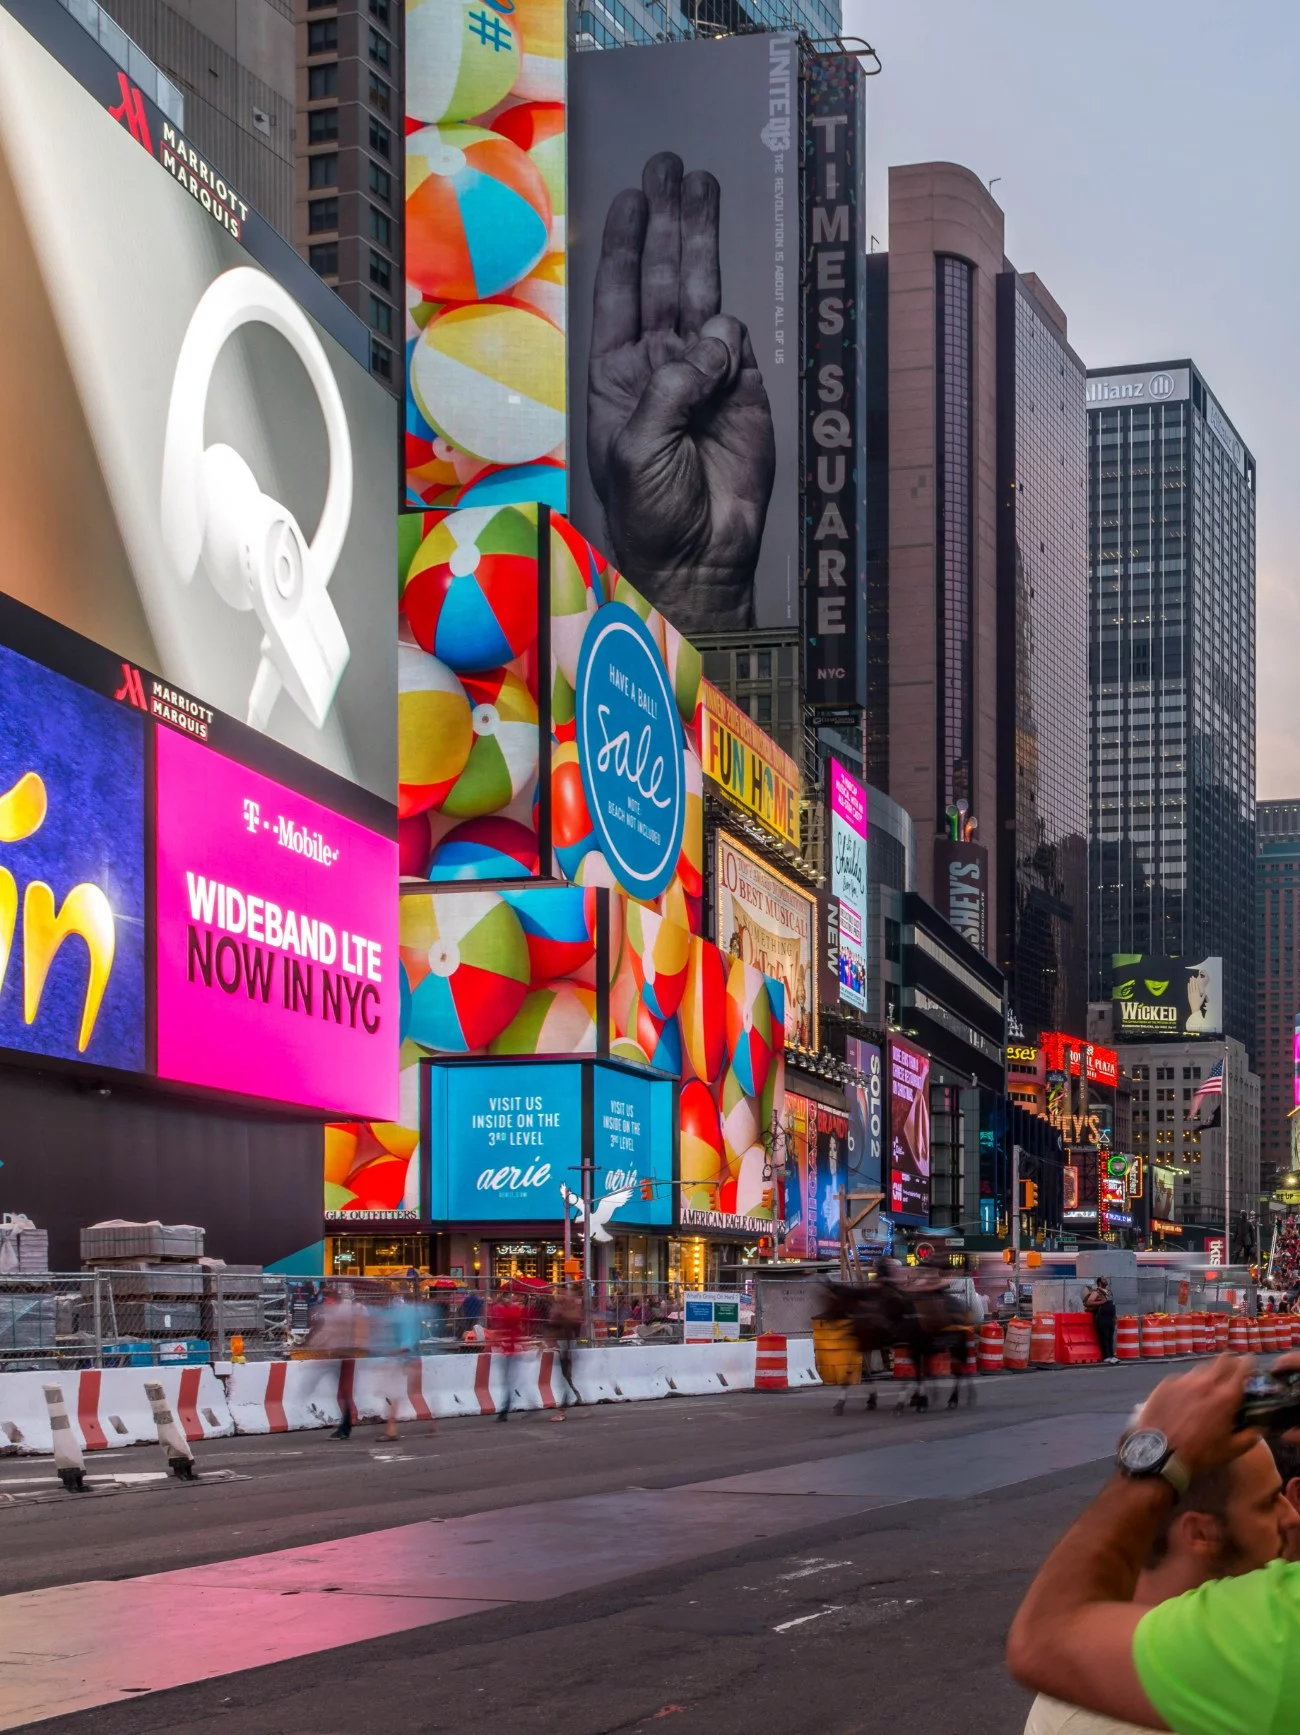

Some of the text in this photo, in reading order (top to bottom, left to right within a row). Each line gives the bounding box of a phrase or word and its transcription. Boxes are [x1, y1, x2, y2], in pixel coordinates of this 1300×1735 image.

[163, 123, 249, 221] MARRIOTT
[162, 149, 240, 238] MARQUIS
[811, 115, 849, 334] TIMES
[774, 152, 785, 364] THE REVOLUTION IS ABOUT ALL OF US
[812, 364, 852, 635] SQUARE
[609, 664, 658, 719] HAVE A BALL!
[817, 667, 846, 680] NYC
[153, 681, 213, 723] MARRIOTT
[153, 699, 207, 739] MARQUIS
[598, 704, 671, 808] Sale
[709, 717, 745, 798] FUN
[752, 754, 795, 841] HOME
[608, 801, 661, 846] BEACH NOT INCLUDED
[186, 872, 382, 982] WIDEBAND LTE
[740, 878, 762, 910] BEST
[765, 896, 808, 938] MUSICAL!
[742, 915, 793, 957] SOMETHING
[827, 903, 840, 977] NEW
[187, 925, 381, 1035] NOW IN NYC
[472, 1112, 560, 1129] INSIDE ON THE
[488, 1096, 542, 1112] VISIT US
[610, 1100, 634, 1118] VISIT US
[818, 1111, 848, 1139] BRANDY
[870, 1054, 881, 1158] SOLO 2
[509, 1130, 544, 1146] LEVEL
[603, 1115, 641, 1136] INSIDE ON THE
[619, 1136, 634, 1152] LEVEL
[476, 1155, 552, 1191] aerie
[604, 1160, 638, 1191] aerie
[350, 1210, 418, 1220] OUTFITTERS
[682, 1209, 723, 1229] AMERICAN
[725, 1213, 748, 1230] EAGLE
